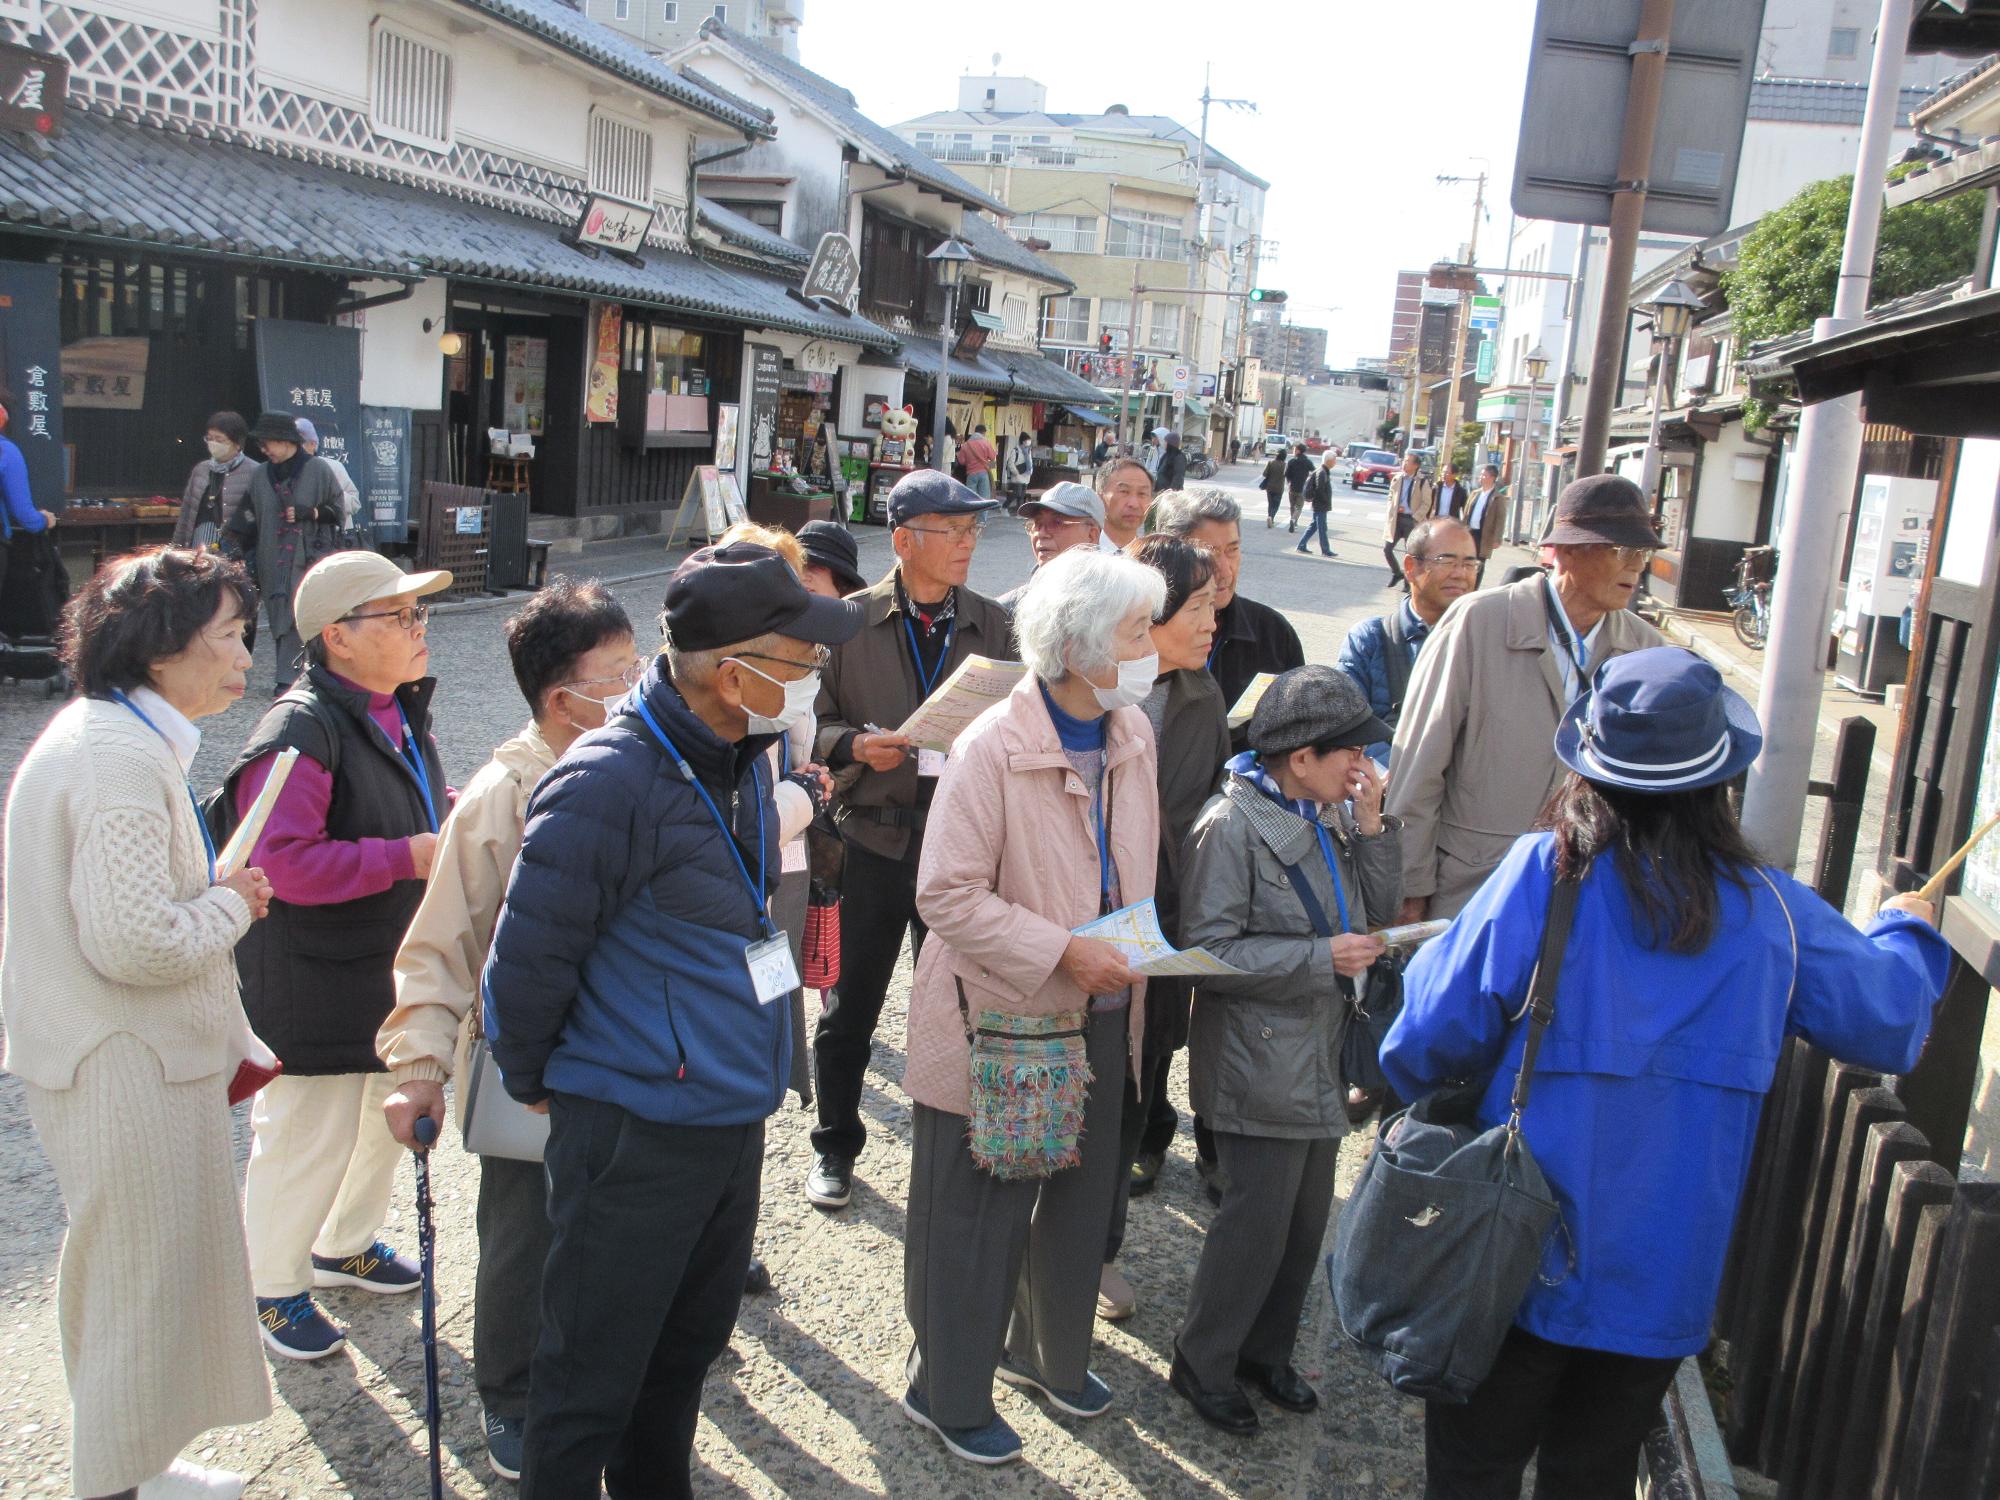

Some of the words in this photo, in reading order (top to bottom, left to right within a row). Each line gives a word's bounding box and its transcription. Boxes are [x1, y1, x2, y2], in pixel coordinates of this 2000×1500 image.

[25, 365, 52, 441] 倉敷屋
[290, 387, 336, 412] 倉敷屋
